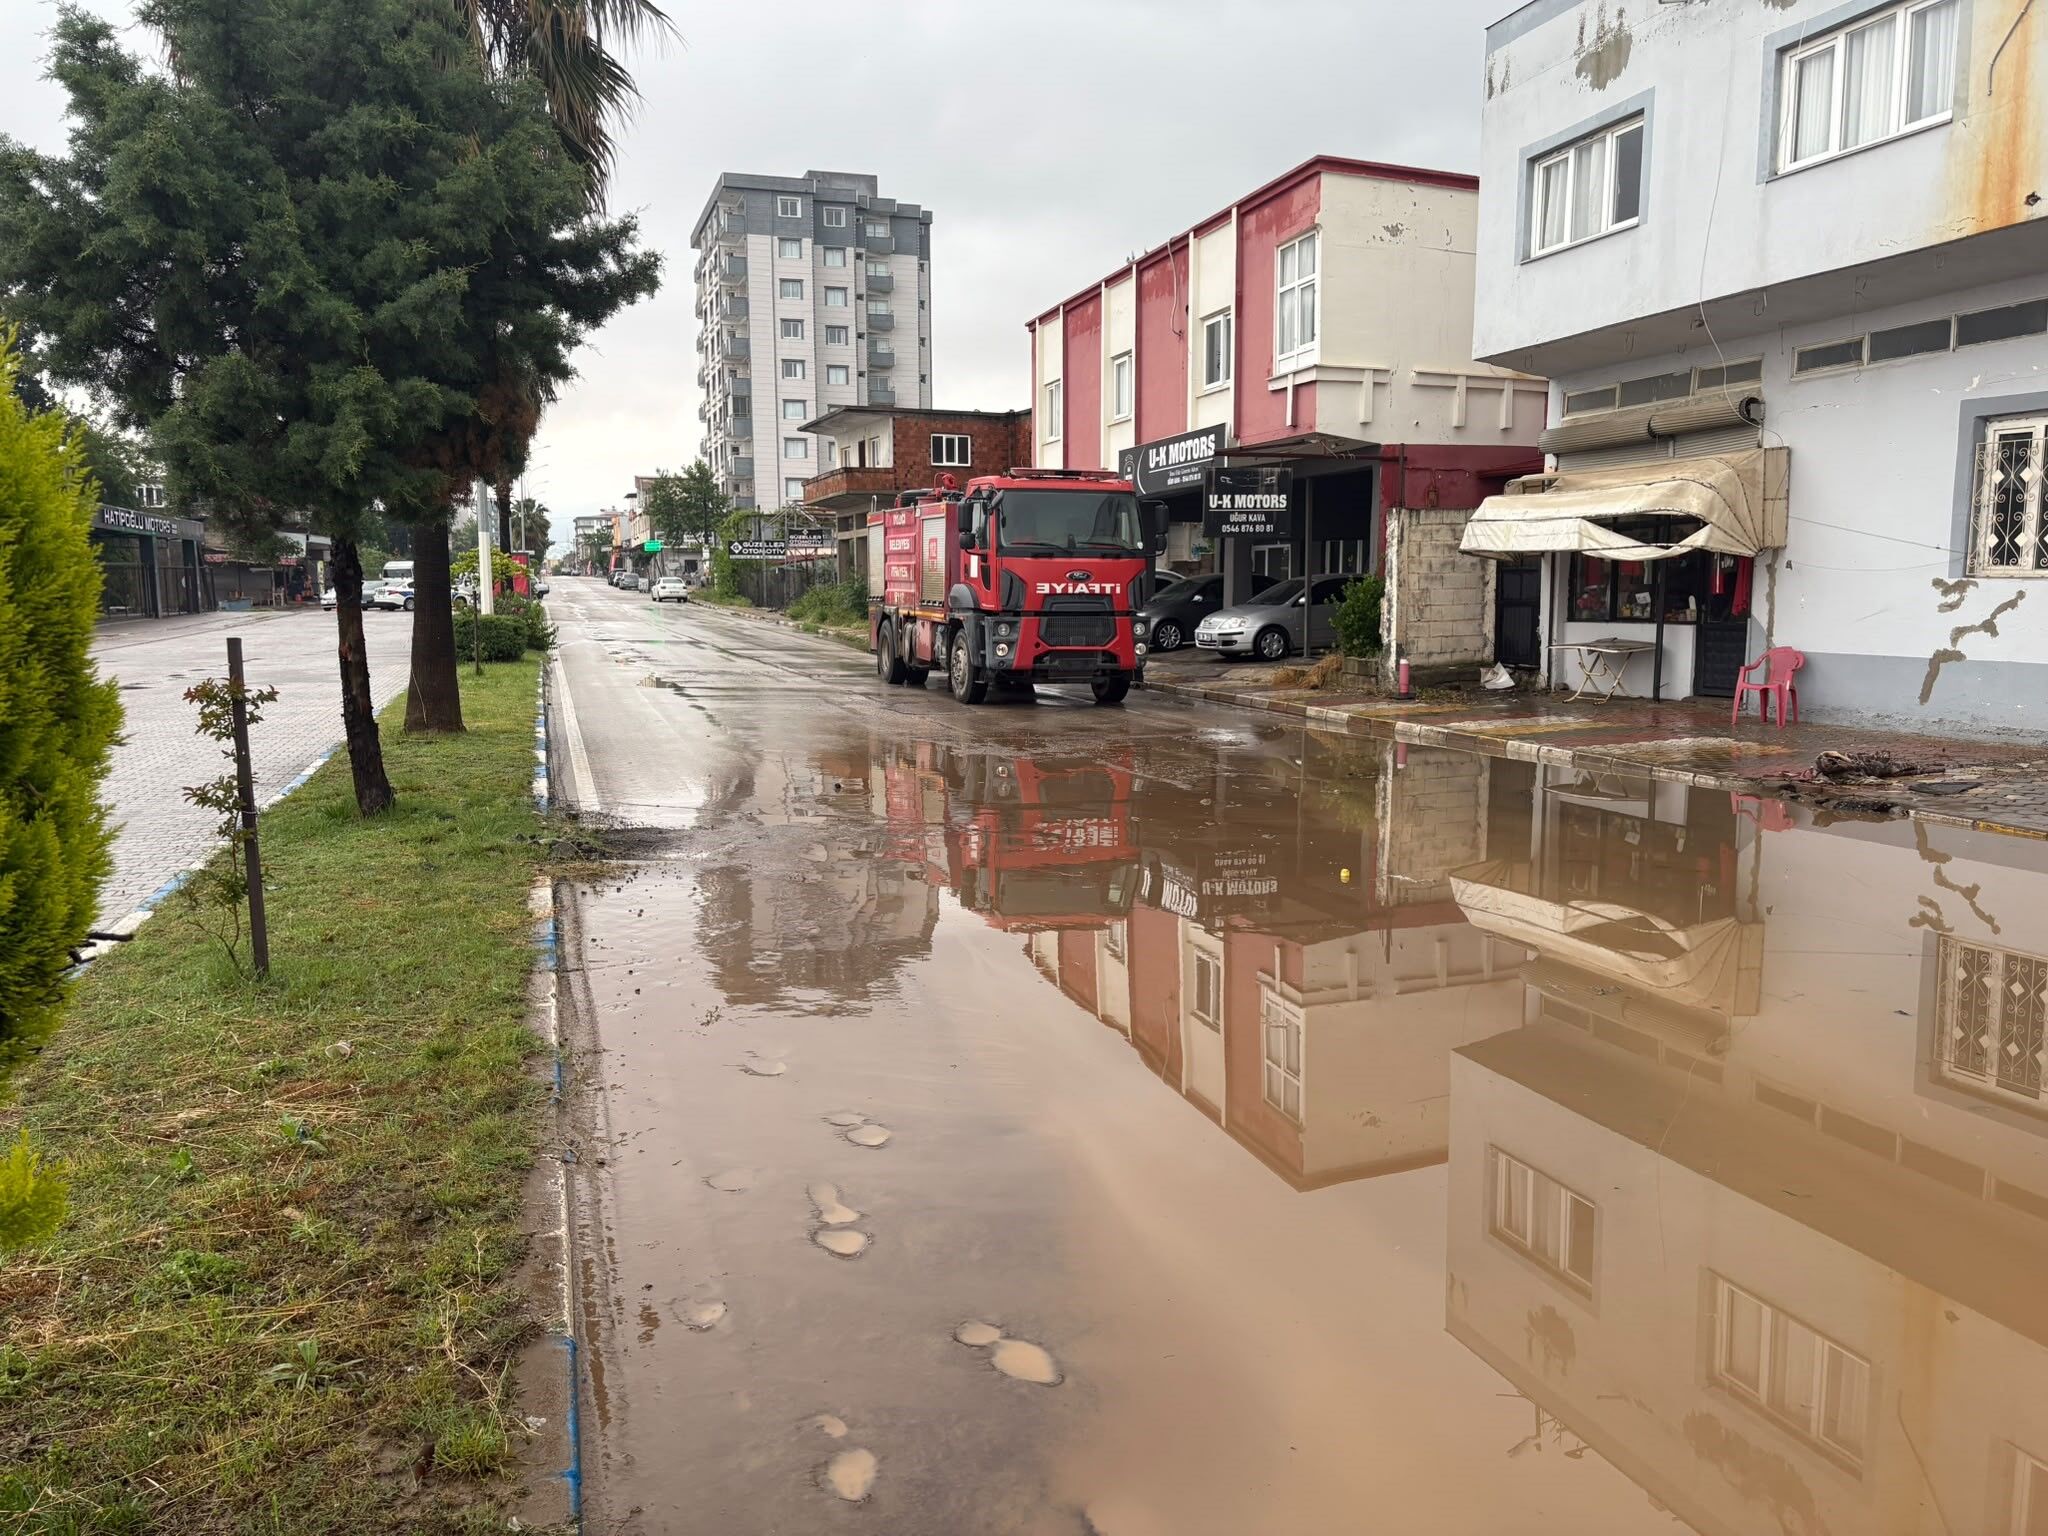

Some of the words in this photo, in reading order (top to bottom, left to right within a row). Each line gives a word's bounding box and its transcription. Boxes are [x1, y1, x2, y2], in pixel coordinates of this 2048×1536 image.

[1148, 445, 1167, 469] U-K
[1168, 433, 1216, 465] MOTORS
[1208, 494, 1232, 509] U-K
[1234, 494, 1287, 509] MOTORS
[145, 516, 171, 534] MOTORS
[1221, 524, 1240, 533] 0546
[1240, 524, 1254, 533] 876
[1255, 524, 1265, 533] 80
[1265, 524, 1274, 533] 81
